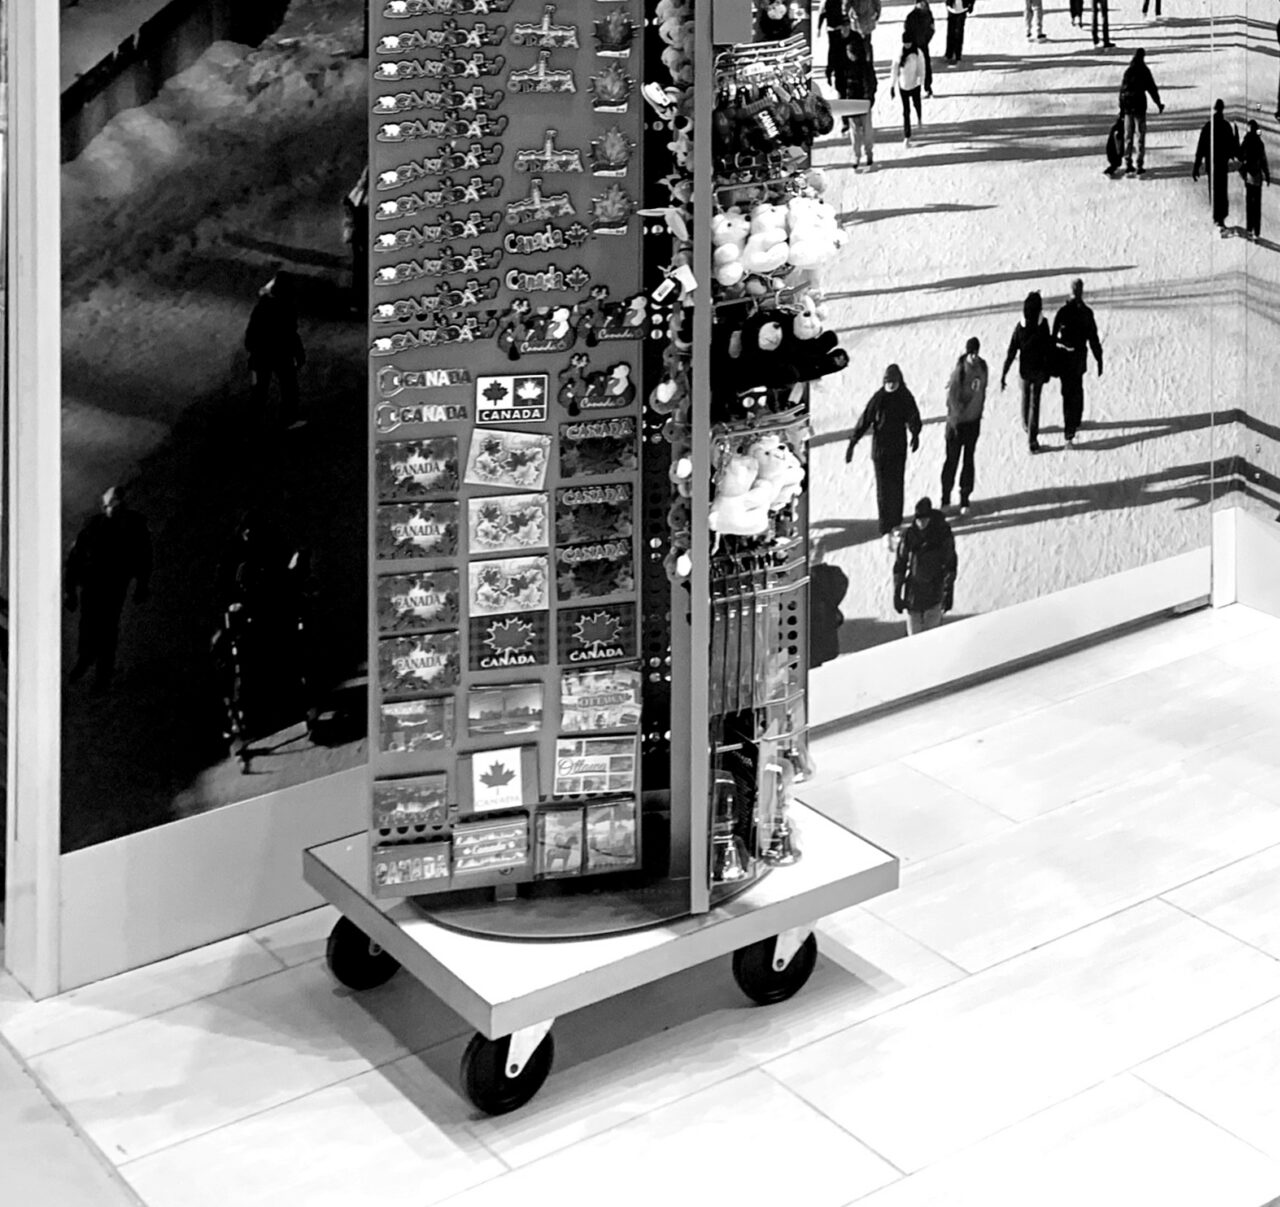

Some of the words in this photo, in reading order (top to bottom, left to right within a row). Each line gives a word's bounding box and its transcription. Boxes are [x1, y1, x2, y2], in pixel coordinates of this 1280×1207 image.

[504, 224, 568, 254] Canada
[505, 265, 567, 292] Canada
[598, 329, 634, 339] Canada
[520, 341, 556, 353] Canada
[403, 369, 471, 388] CANADA
[580, 397, 616, 409] Canada
[400, 405, 468, 423] CANADA
[482, 409, 542, 421] CANADA
[394, 461, 441, 477] CANADA
[394, 524, 441, 538] CANADA
[396, 594, 441, 609] CANADA
[480, 654, 536, 668] CANADA
[569, 647, 624, 662] CANADA
[396, 655, 442, 670] CANADA
